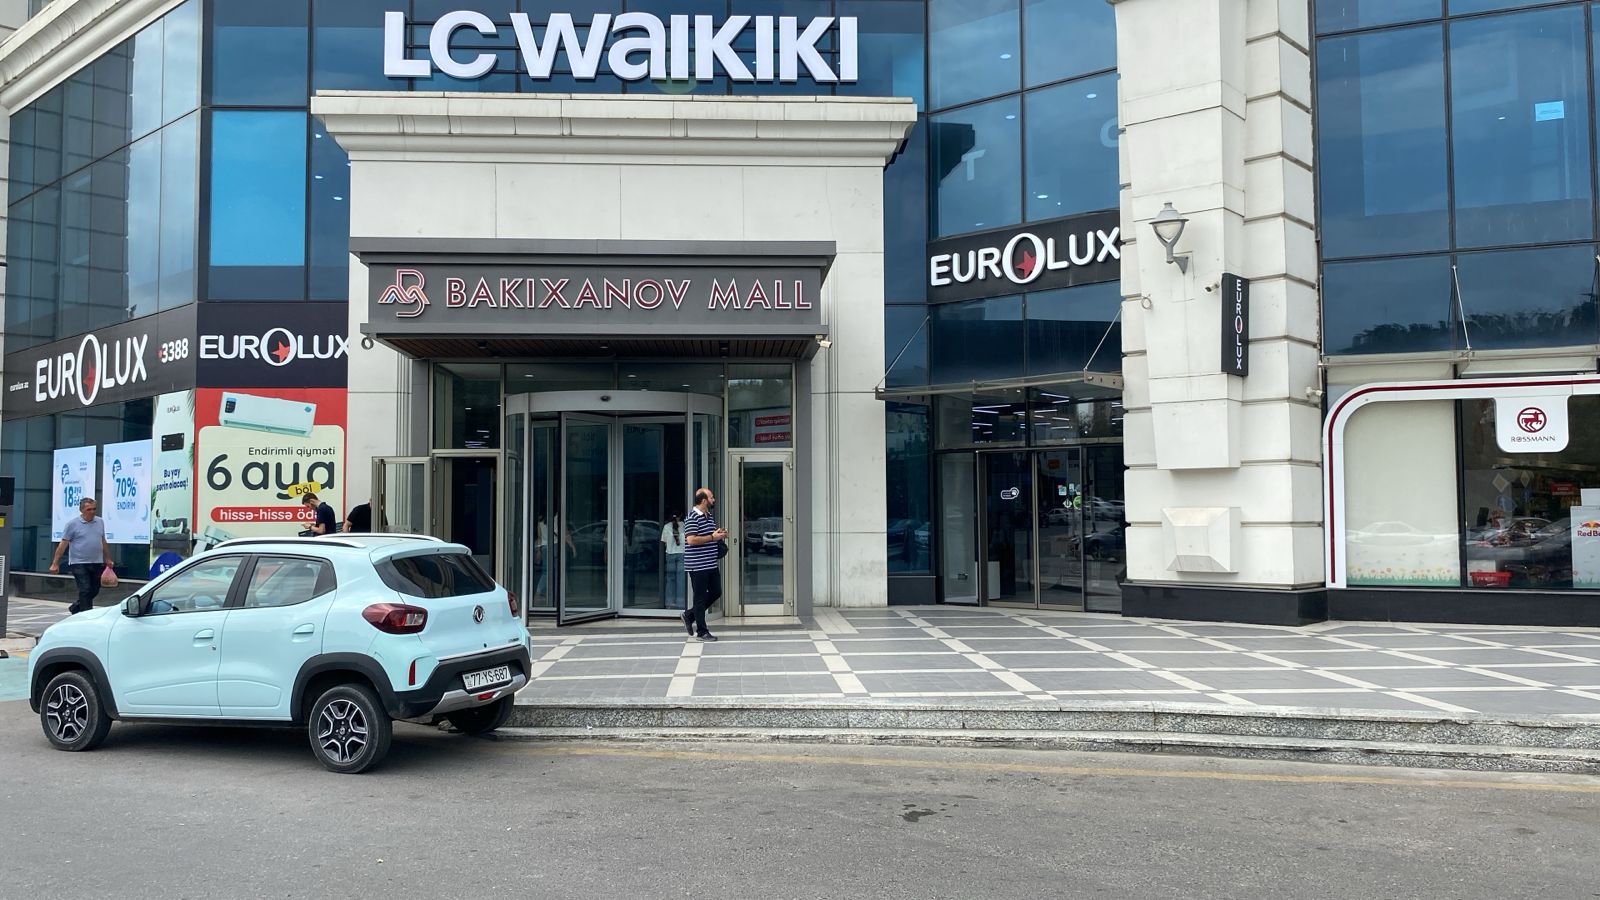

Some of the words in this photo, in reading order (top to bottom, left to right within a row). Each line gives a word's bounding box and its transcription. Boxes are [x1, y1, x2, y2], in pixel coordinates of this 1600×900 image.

[384, 10, 498, 78] LC
[930, 226, 1121, 287] EUROLUX
[446, 276, 691, 310] BAKIXANOV
[708, 278, 812, 310] MALL
[1235, 279, 1243, 370] EUROLUX
[161, 337, 189, 363] 3388
[199, 327, 349, 367] EUROLUX
[35, 333, 148, 406] EUROLUX
[248, 447, 293, 456] Endirimli
[296, 447, 336, 457] qiyməti
[116, 477, 137, 497] 70%
[207, 453, 232, 491] 6
[241, 461, 335, 500] aya
[295, 483, 313, 495] böl
[64, 486, 74, 507] 18
[220, 509, 293, 520] hissə-hissə
[470, 667, 508, 687] 77-YS-687
